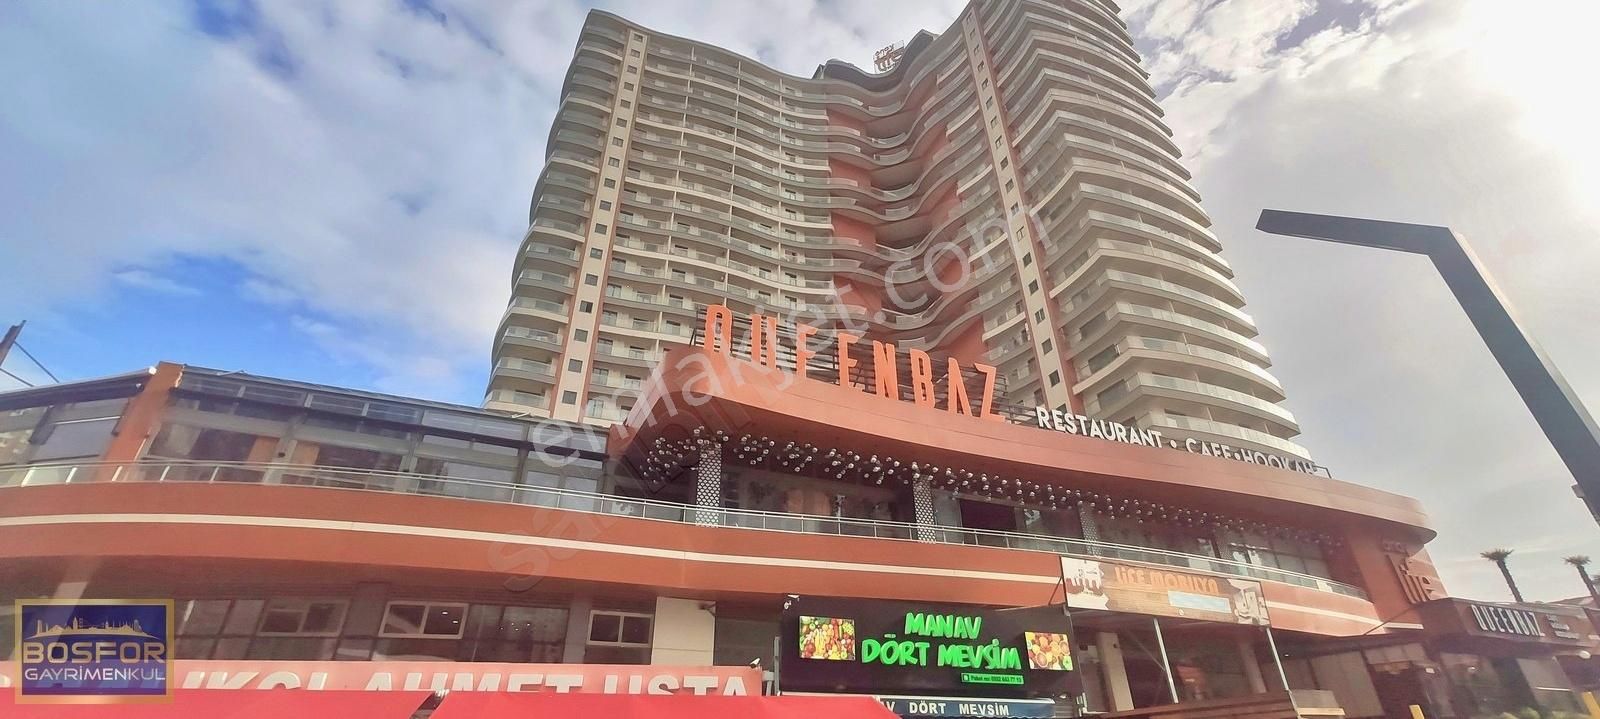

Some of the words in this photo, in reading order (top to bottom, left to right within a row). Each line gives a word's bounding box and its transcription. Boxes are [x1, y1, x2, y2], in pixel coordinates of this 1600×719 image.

[1035, 406, 1162, 448] RESTAURANT
[904, 612, 982, 639] MANAV
[1470, 603, 1545, 637] QUEENBAZ
[861, 633, 930, 666] DÖRT
[937, 638, 1022, 670] MEVSİM
[909, 700, 946, 714] DÖRT
[959, 702, 1009, 716] MEVSİM
